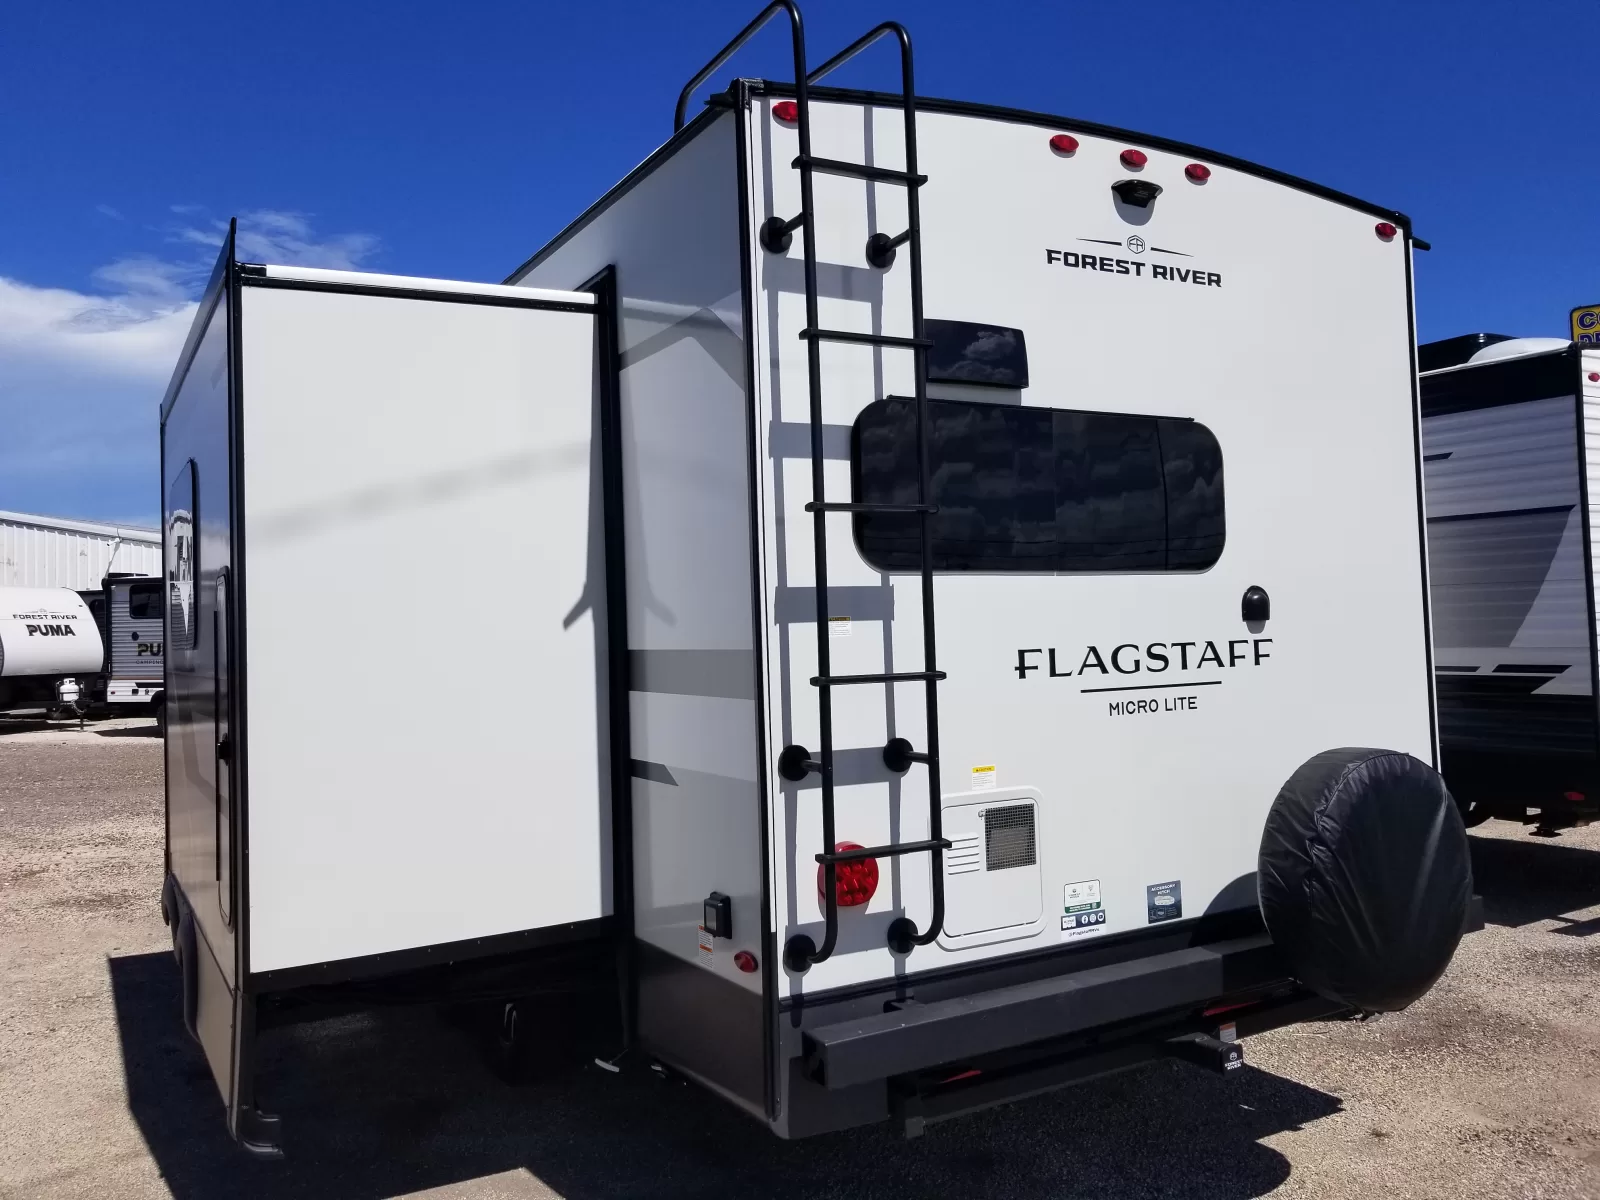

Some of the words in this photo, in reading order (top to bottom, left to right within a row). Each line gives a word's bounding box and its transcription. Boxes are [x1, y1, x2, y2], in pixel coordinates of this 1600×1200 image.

[1045, 248, 1146, 277] FOREST
[1151, 263, 1222, 288] RIVER
[1577, 310, 1600, 330] C
[25, 624, 76, 636] PUMA
[136, 643, 164, 656] PU
[1014, 638, 1274, 679] FLAGSTAFF
[1109, 698, 1159, 717] MICRO
[1164, 696, 1198, 712] LITE
